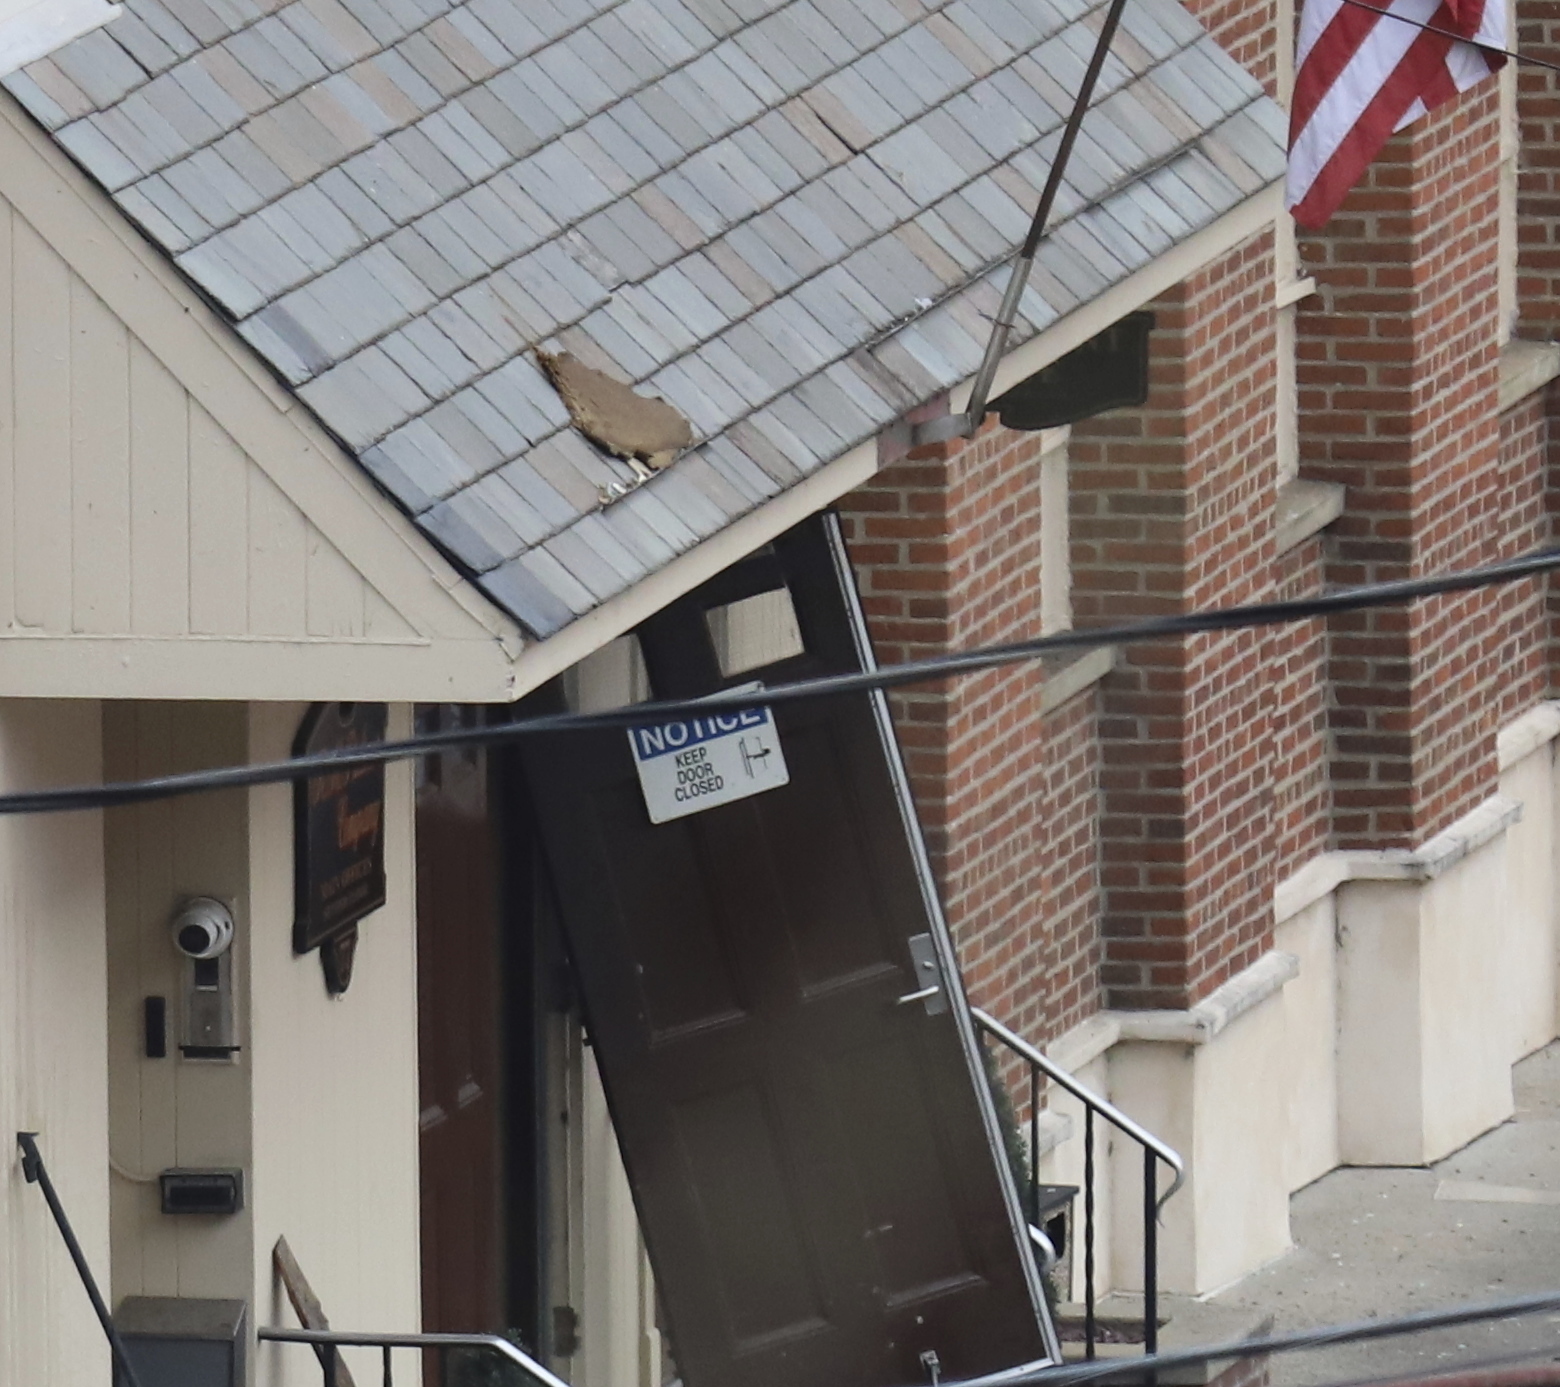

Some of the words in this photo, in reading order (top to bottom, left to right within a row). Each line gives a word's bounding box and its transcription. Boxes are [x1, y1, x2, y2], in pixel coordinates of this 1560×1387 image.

[675, 747, 707, 768] KEEP
[677, 763, 714, 785] DOOR
[675, 775, 724, 801] CLOSED
